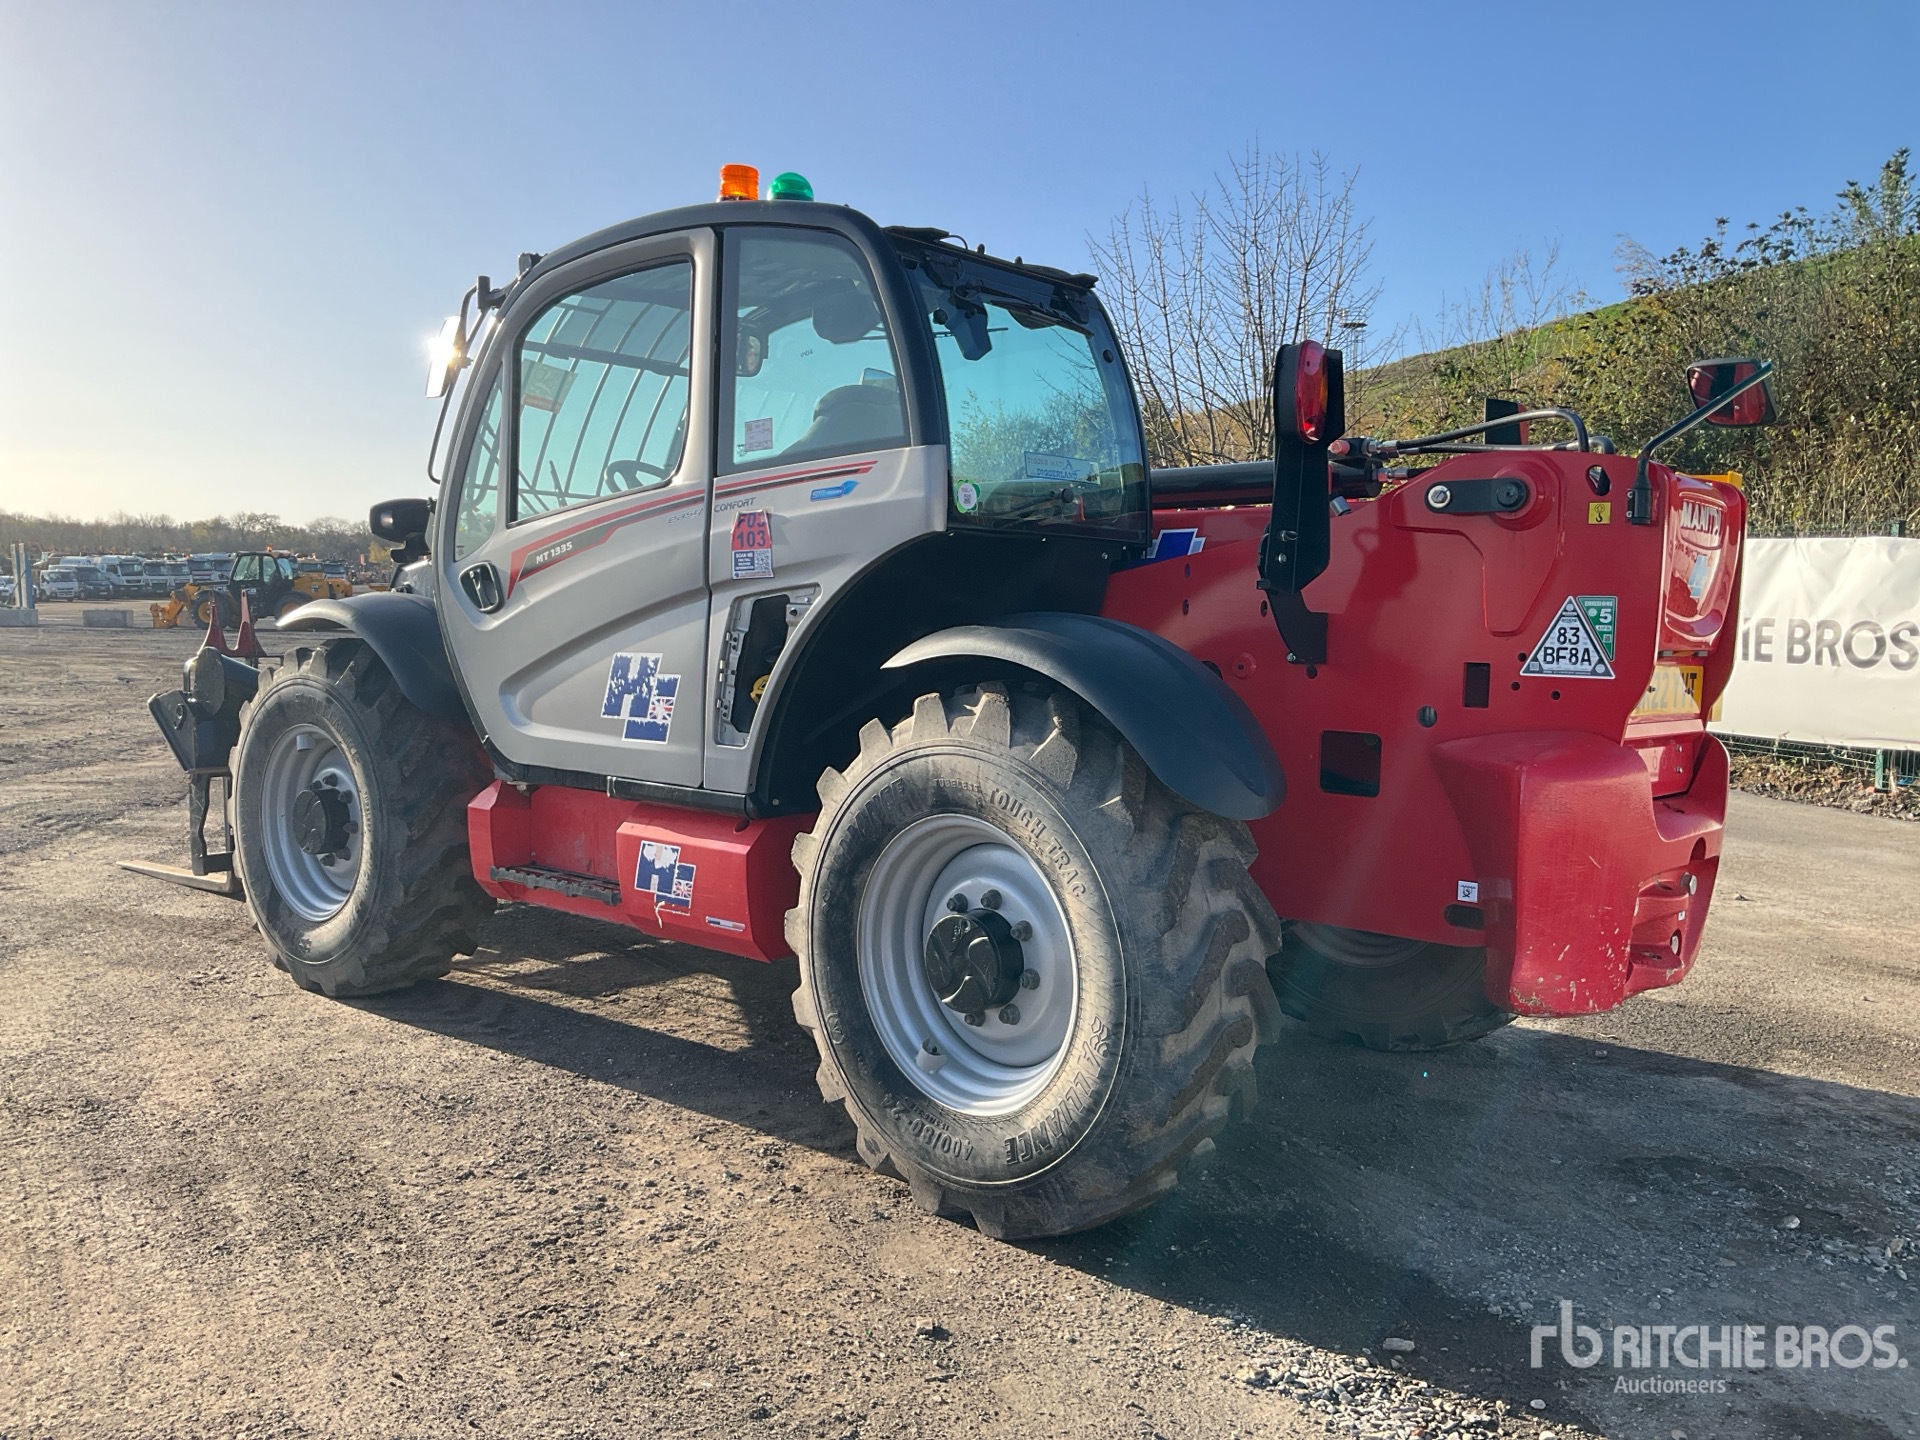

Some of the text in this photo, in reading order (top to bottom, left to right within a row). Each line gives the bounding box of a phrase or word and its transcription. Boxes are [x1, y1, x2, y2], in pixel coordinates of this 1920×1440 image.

[1037, 468, 1078, 480] DIGGERLAND
[714, 497, 756, 513] COMFORT
[737, 530, 766, 548] 103
[536, 541, 573, 565] MT 1335
[1599, 608, 1612, 624] 5
[1557, 627, 1580, 645] 83
[1543, 647, 1592, 666] BF8A
[990, 788, 1047, 839] TOUGH
[1048, 837, 1087, 898] TRAC
[1004, 1040, 1102, 1167] ALLIANCE
